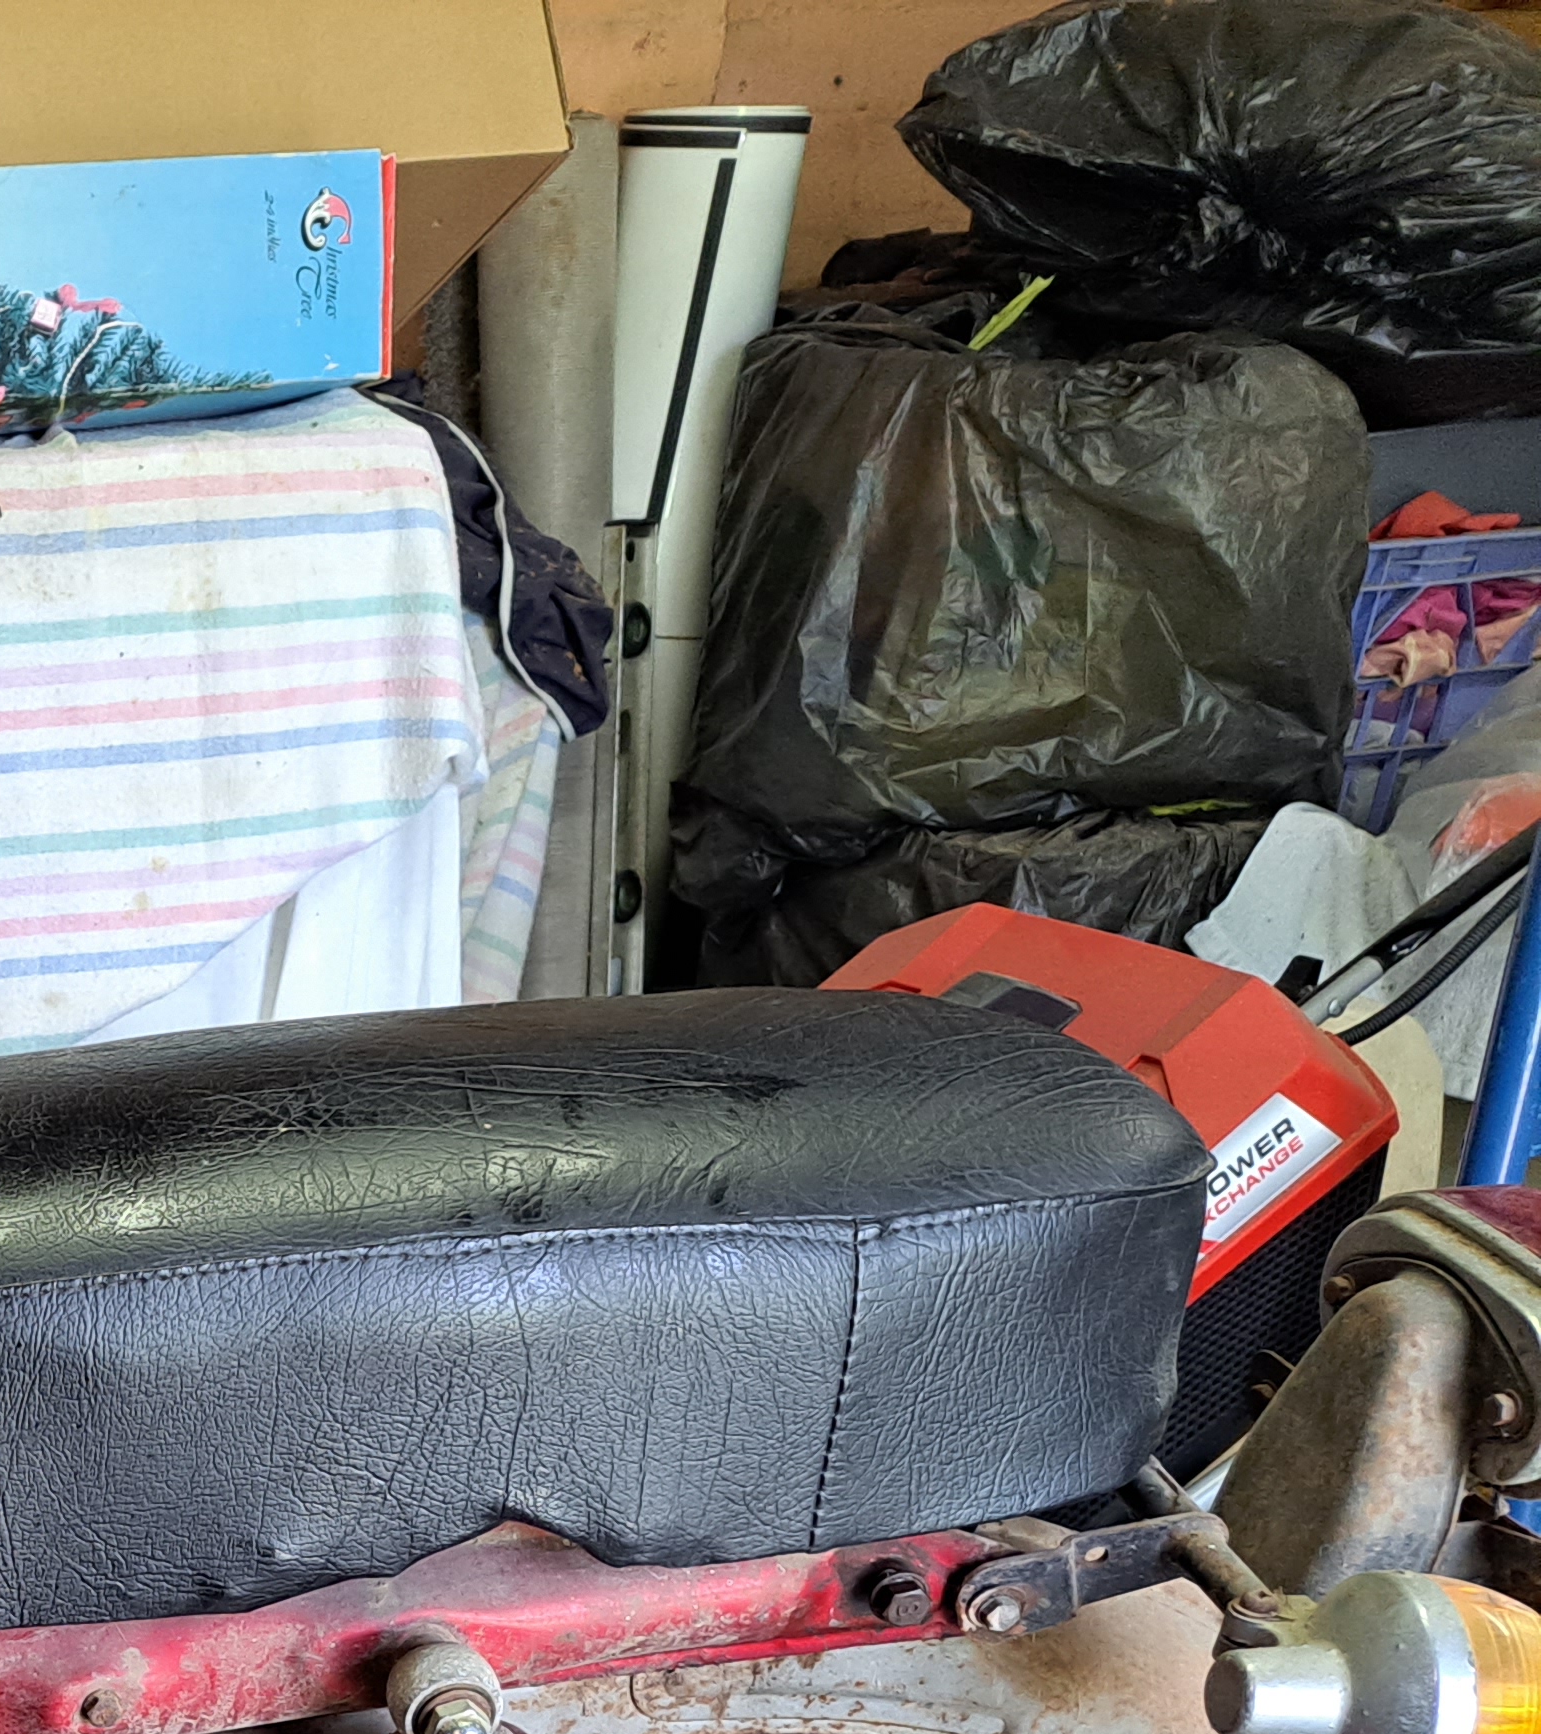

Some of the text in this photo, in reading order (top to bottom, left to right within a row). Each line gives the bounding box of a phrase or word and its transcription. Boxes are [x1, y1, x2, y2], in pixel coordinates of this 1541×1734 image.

[296, 257, 322, 320] Tree
[301, 187, 353, 319] Christmas
[1204, 1134, 1305, 1227] XCHANGE
[1207, 1116, 1297, 1198] OWER
